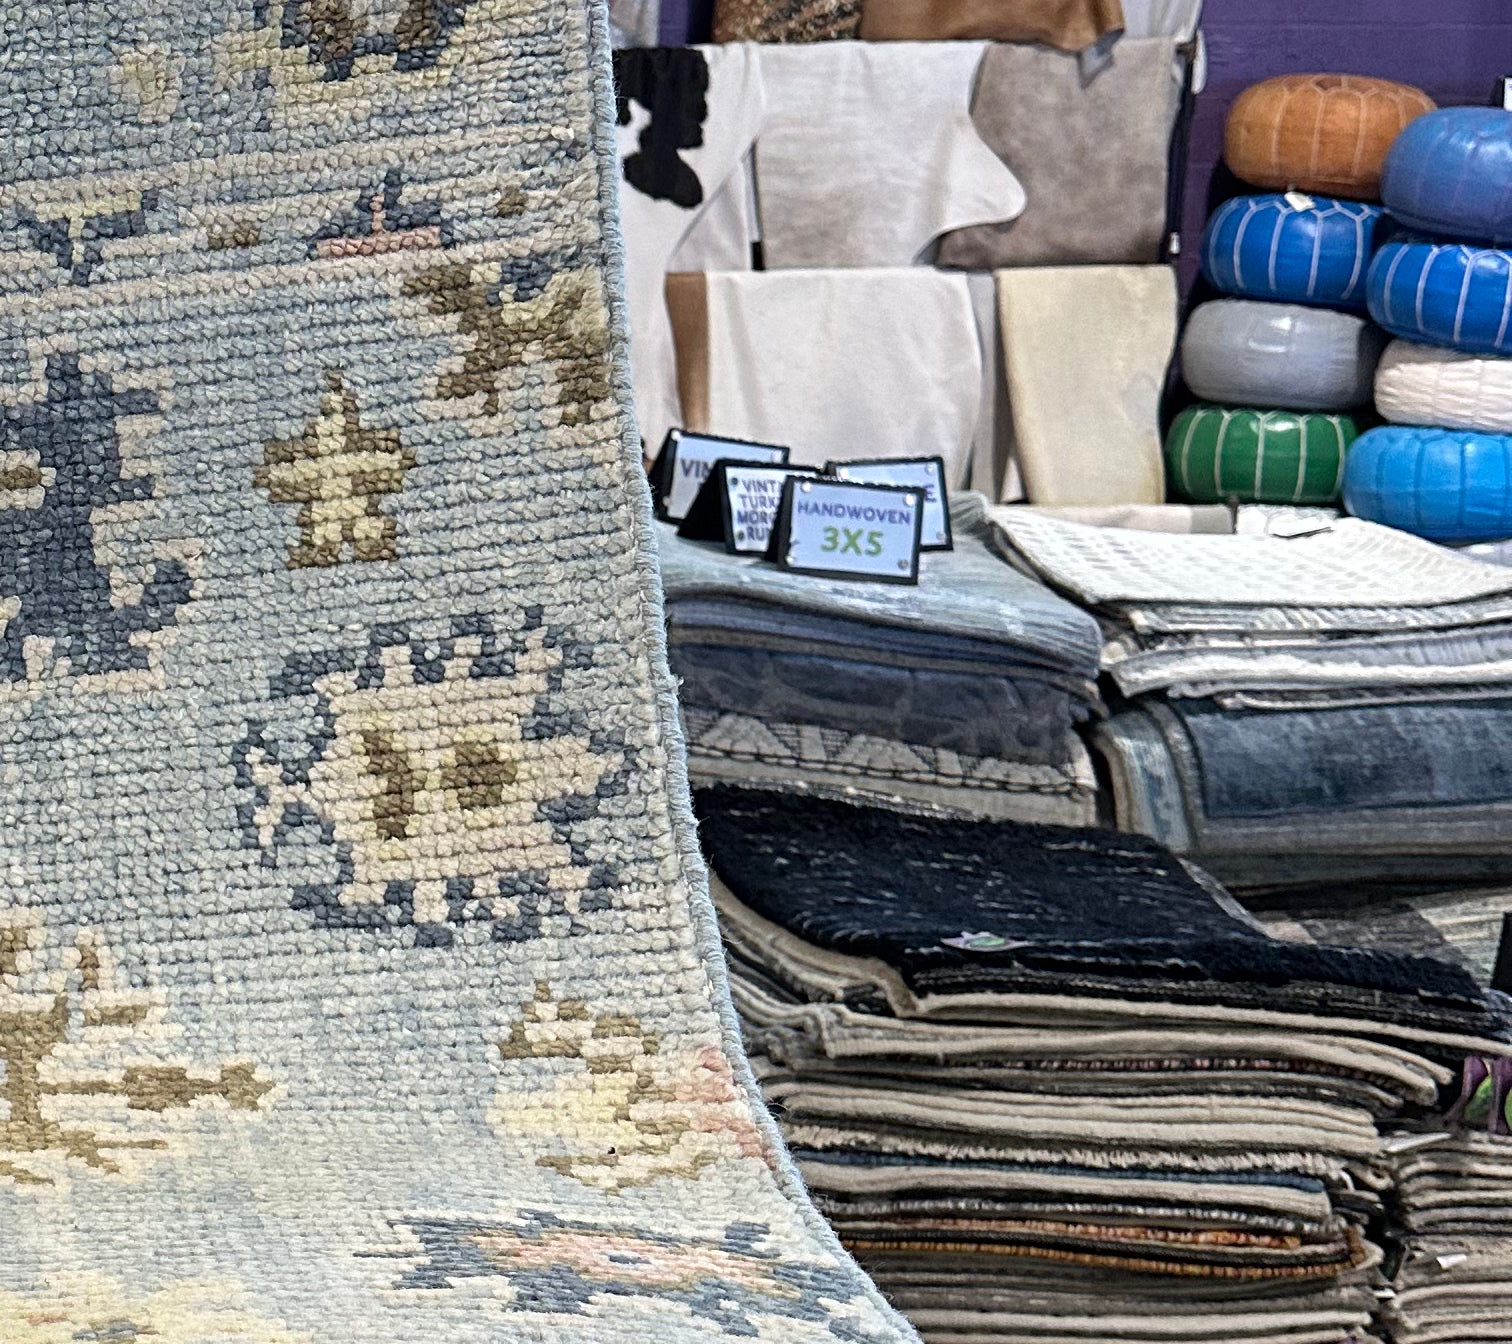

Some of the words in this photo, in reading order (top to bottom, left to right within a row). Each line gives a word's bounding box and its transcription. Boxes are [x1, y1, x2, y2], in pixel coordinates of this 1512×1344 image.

[738, 494, 779, 509] TURK
[797, 500, 910, 525] HANDWOVEN
[821, 525, 884, 555] 3X5
